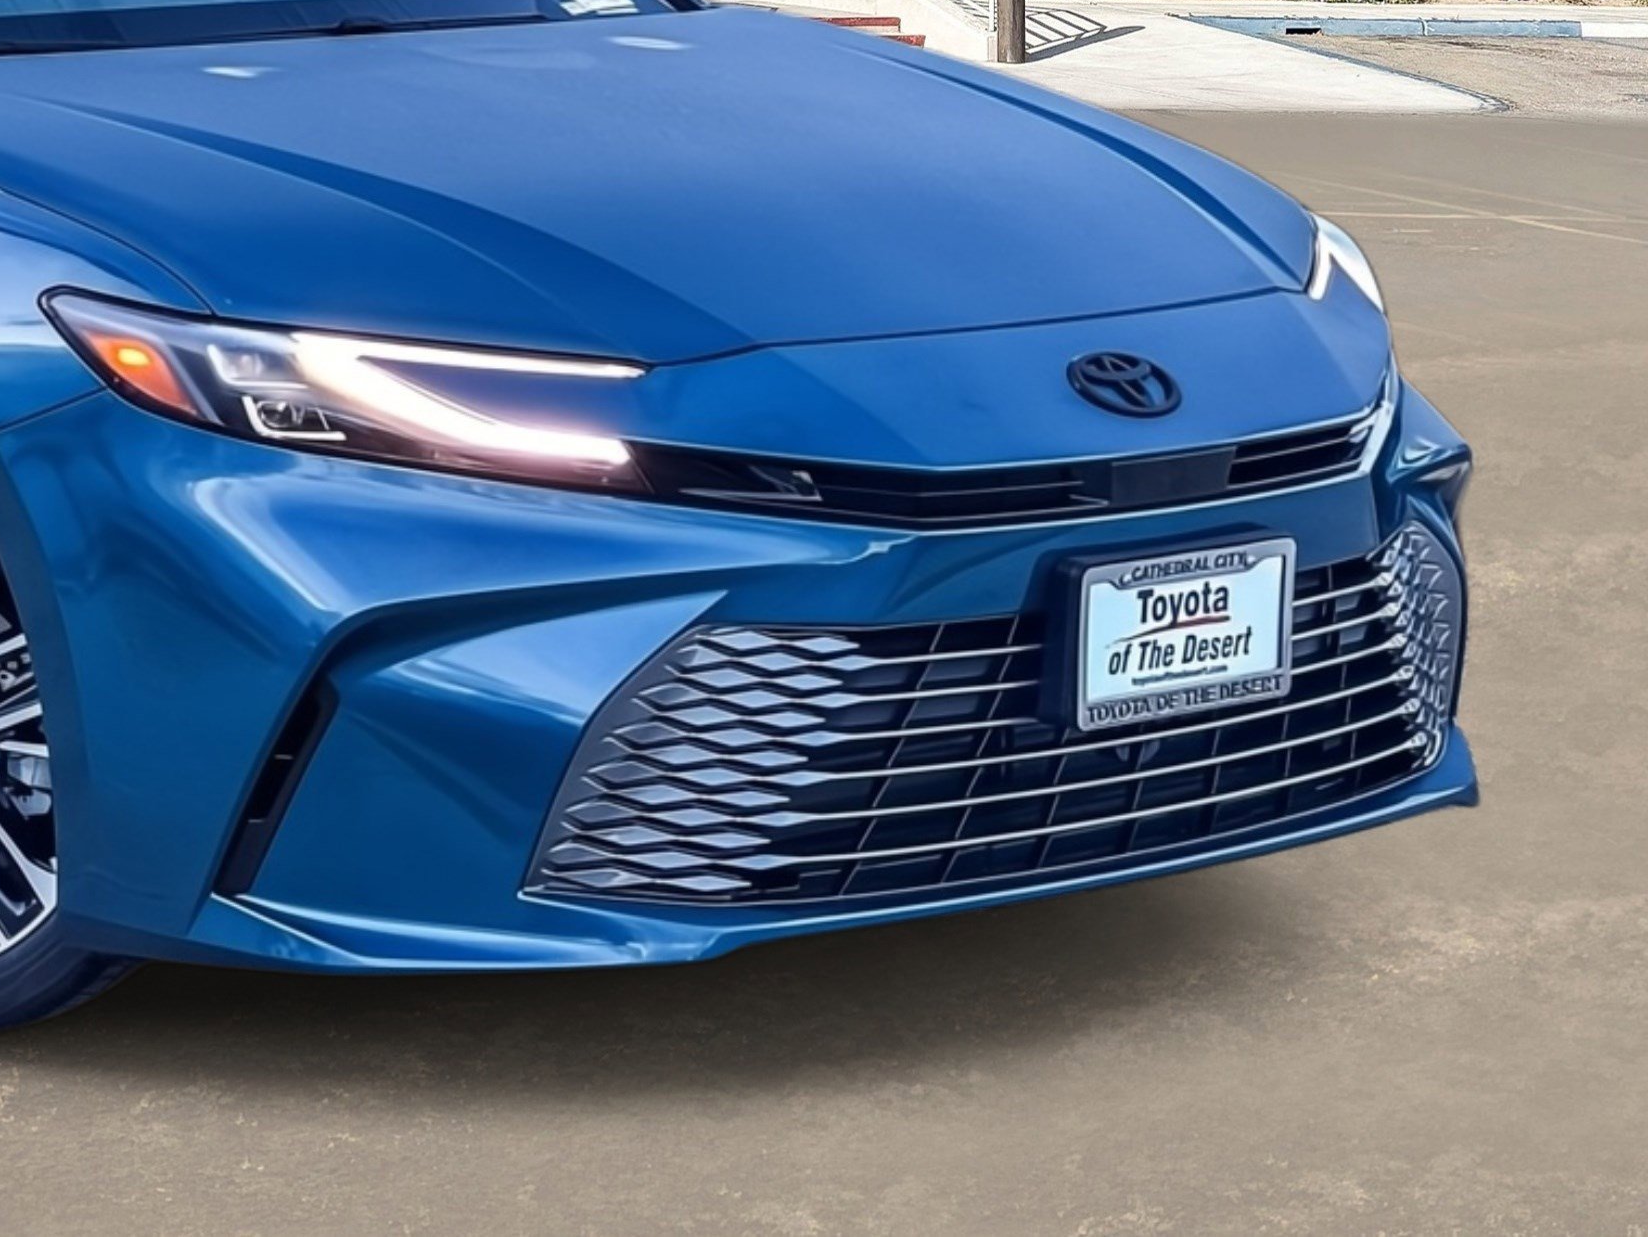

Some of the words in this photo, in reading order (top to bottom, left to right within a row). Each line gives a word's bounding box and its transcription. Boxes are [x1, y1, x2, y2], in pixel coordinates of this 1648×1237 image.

[1131, 555, 1210, 580] CATHEDRAL
[1137, 581, 1229, 624] Toyota
[1108, 641, 1133, 675] of
[1137, 639, 1176, 671] The
[1181, 625, 1253, 664] Desert
[1219, 674, 1284, 699] DESERT
